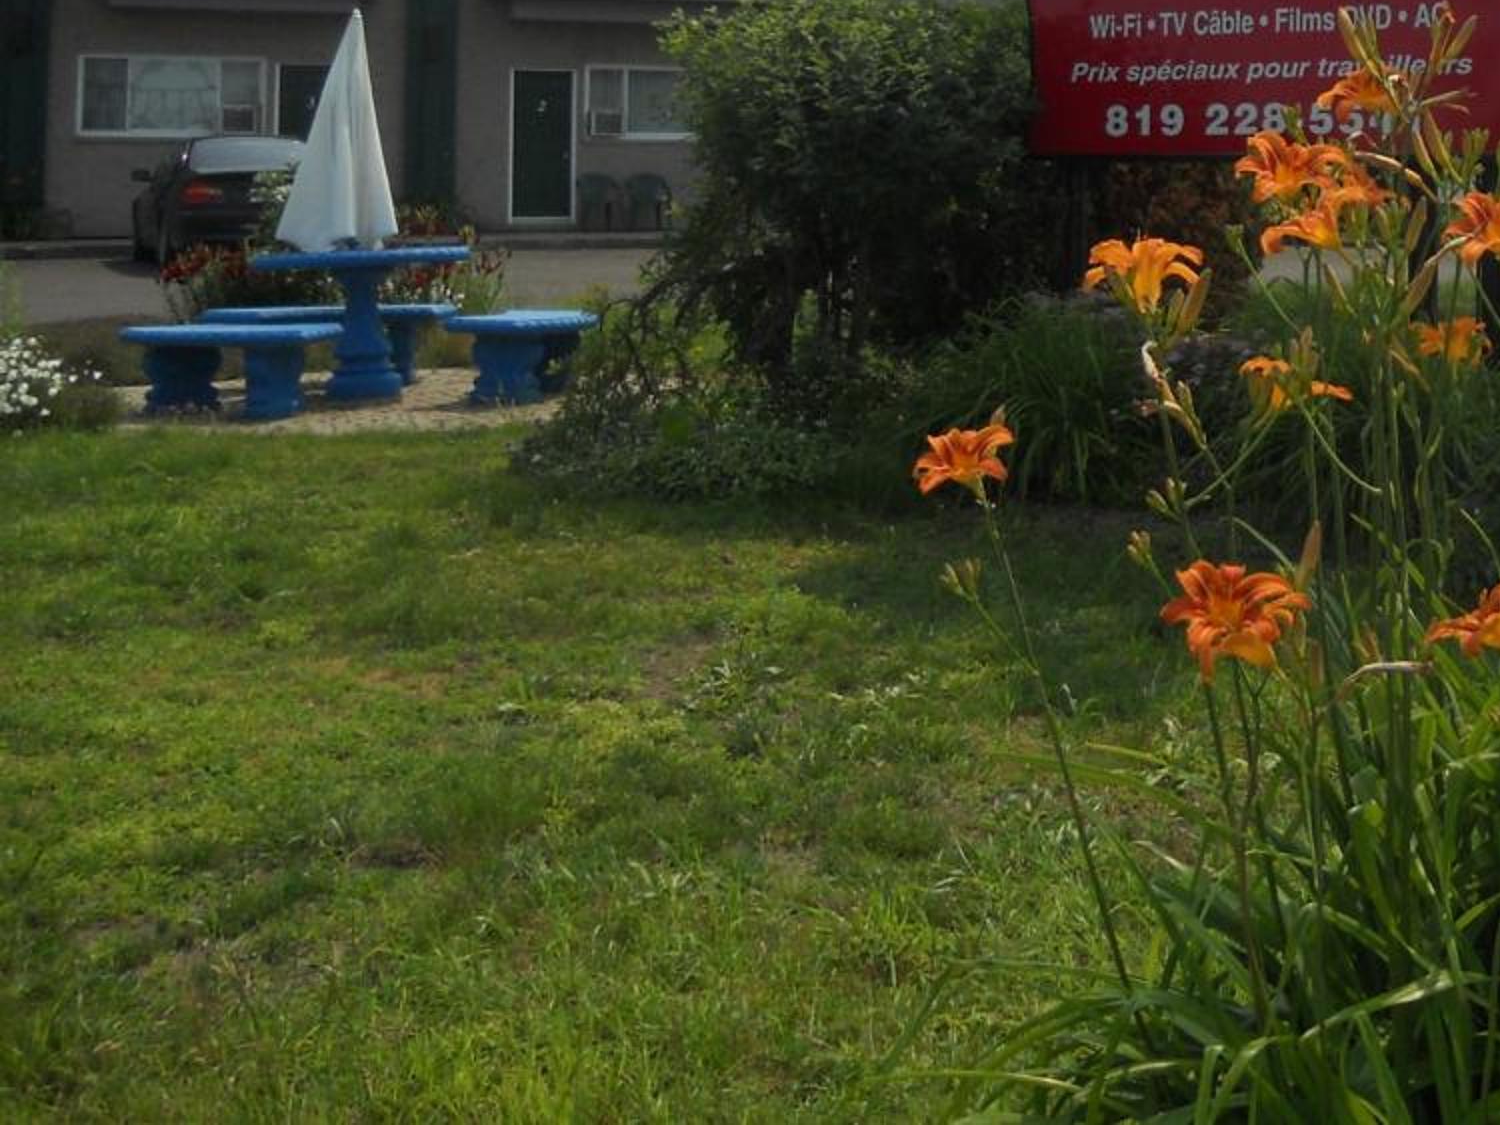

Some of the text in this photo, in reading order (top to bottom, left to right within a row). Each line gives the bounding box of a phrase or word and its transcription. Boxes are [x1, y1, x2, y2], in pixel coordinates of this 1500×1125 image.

[1088, 13, 1142, 38] Wi-Fi
[1158, 11, 1187, 36] TV
[1193, 9, 1254, 35] Câble
[1274, 6, 1335, 32] Films
[1071, 61, 1120, 83] Prix
[1126, 59, 1240, 85] spéciaux
[1246, 58, 1311, 83] pour
[1105, 103, 1184, 136] 819
